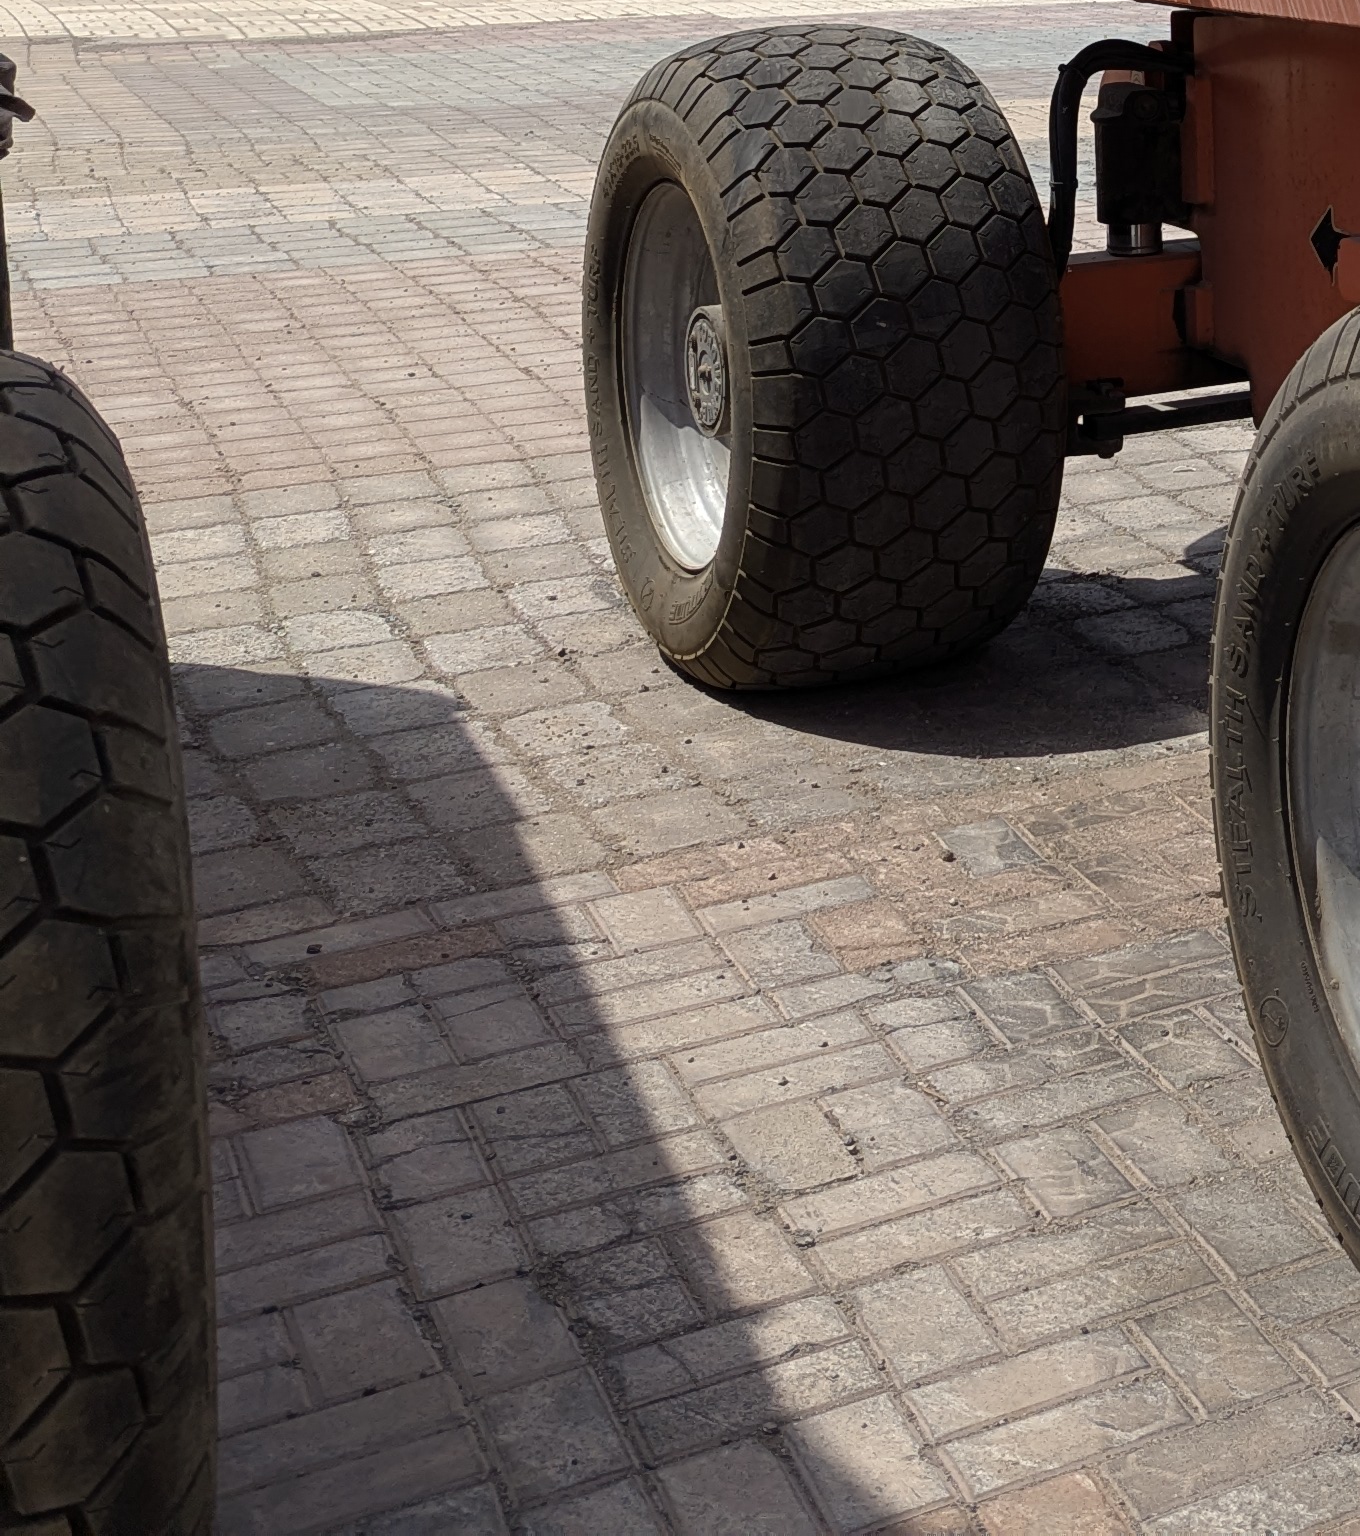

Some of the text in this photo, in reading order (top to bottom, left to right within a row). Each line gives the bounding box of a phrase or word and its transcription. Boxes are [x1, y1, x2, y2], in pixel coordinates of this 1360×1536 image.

[1266, 451, 1322, 530] TURF
[1228, 554, 1266, 678] SAND
[1225, 684, 1259, 921] STEALTH
